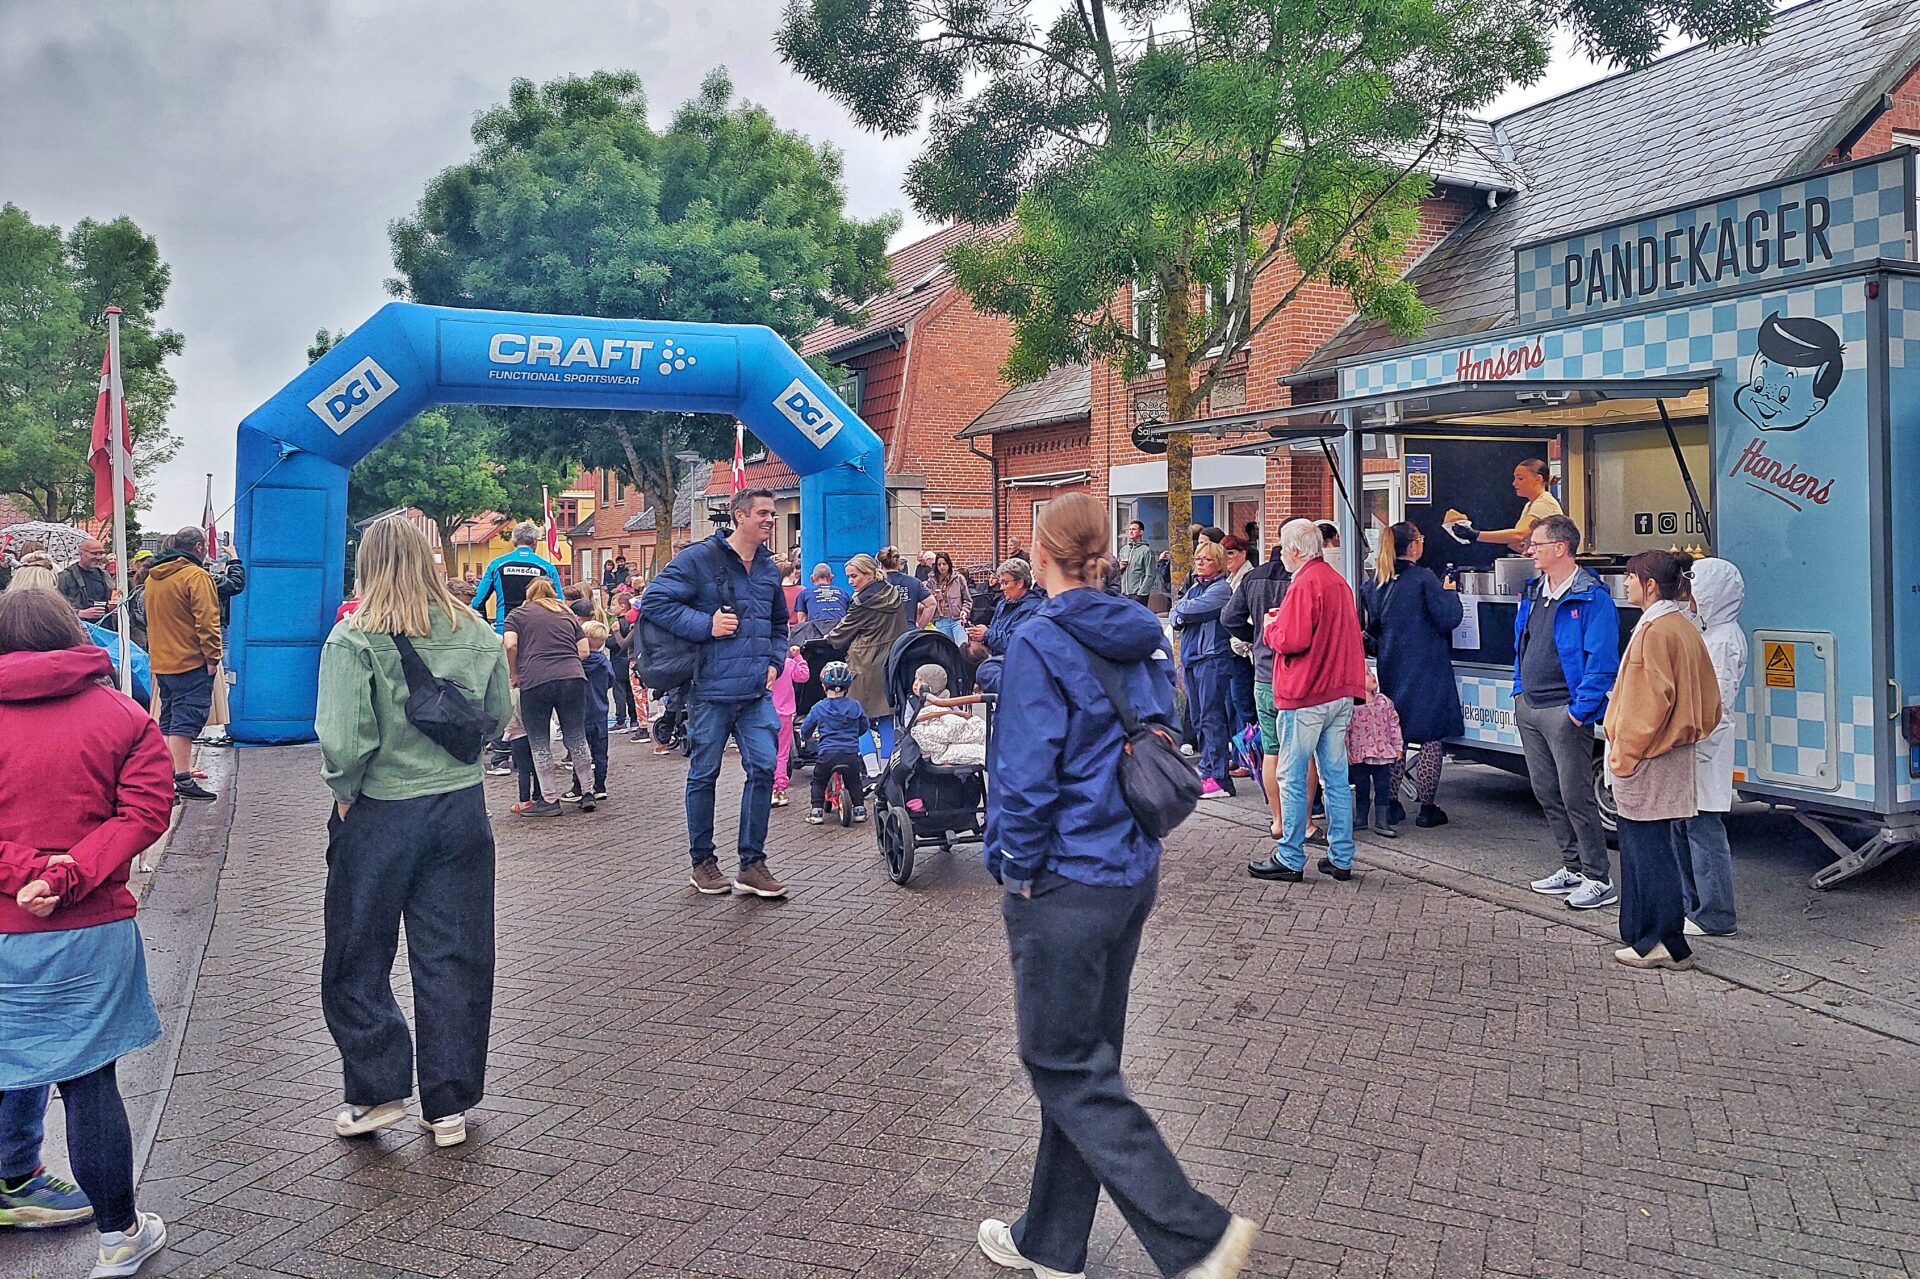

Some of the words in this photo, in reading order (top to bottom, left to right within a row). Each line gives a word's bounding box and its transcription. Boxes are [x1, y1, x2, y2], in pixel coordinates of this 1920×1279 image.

[1565, 196, 1833, 310] PANDEKAGER
[489, 333, 654, 370] CRAFT
[1456, 335, 1546, 381] Hansens
[325, 368, 382, 422] DGI
[489, 370, 561, 383] FUNCTIONAL
[563, 373, 640, 386] SPORTSWEAR
[784, 391, 834, 436] DGI
[1729, 437, 1835, 505] Hansens
